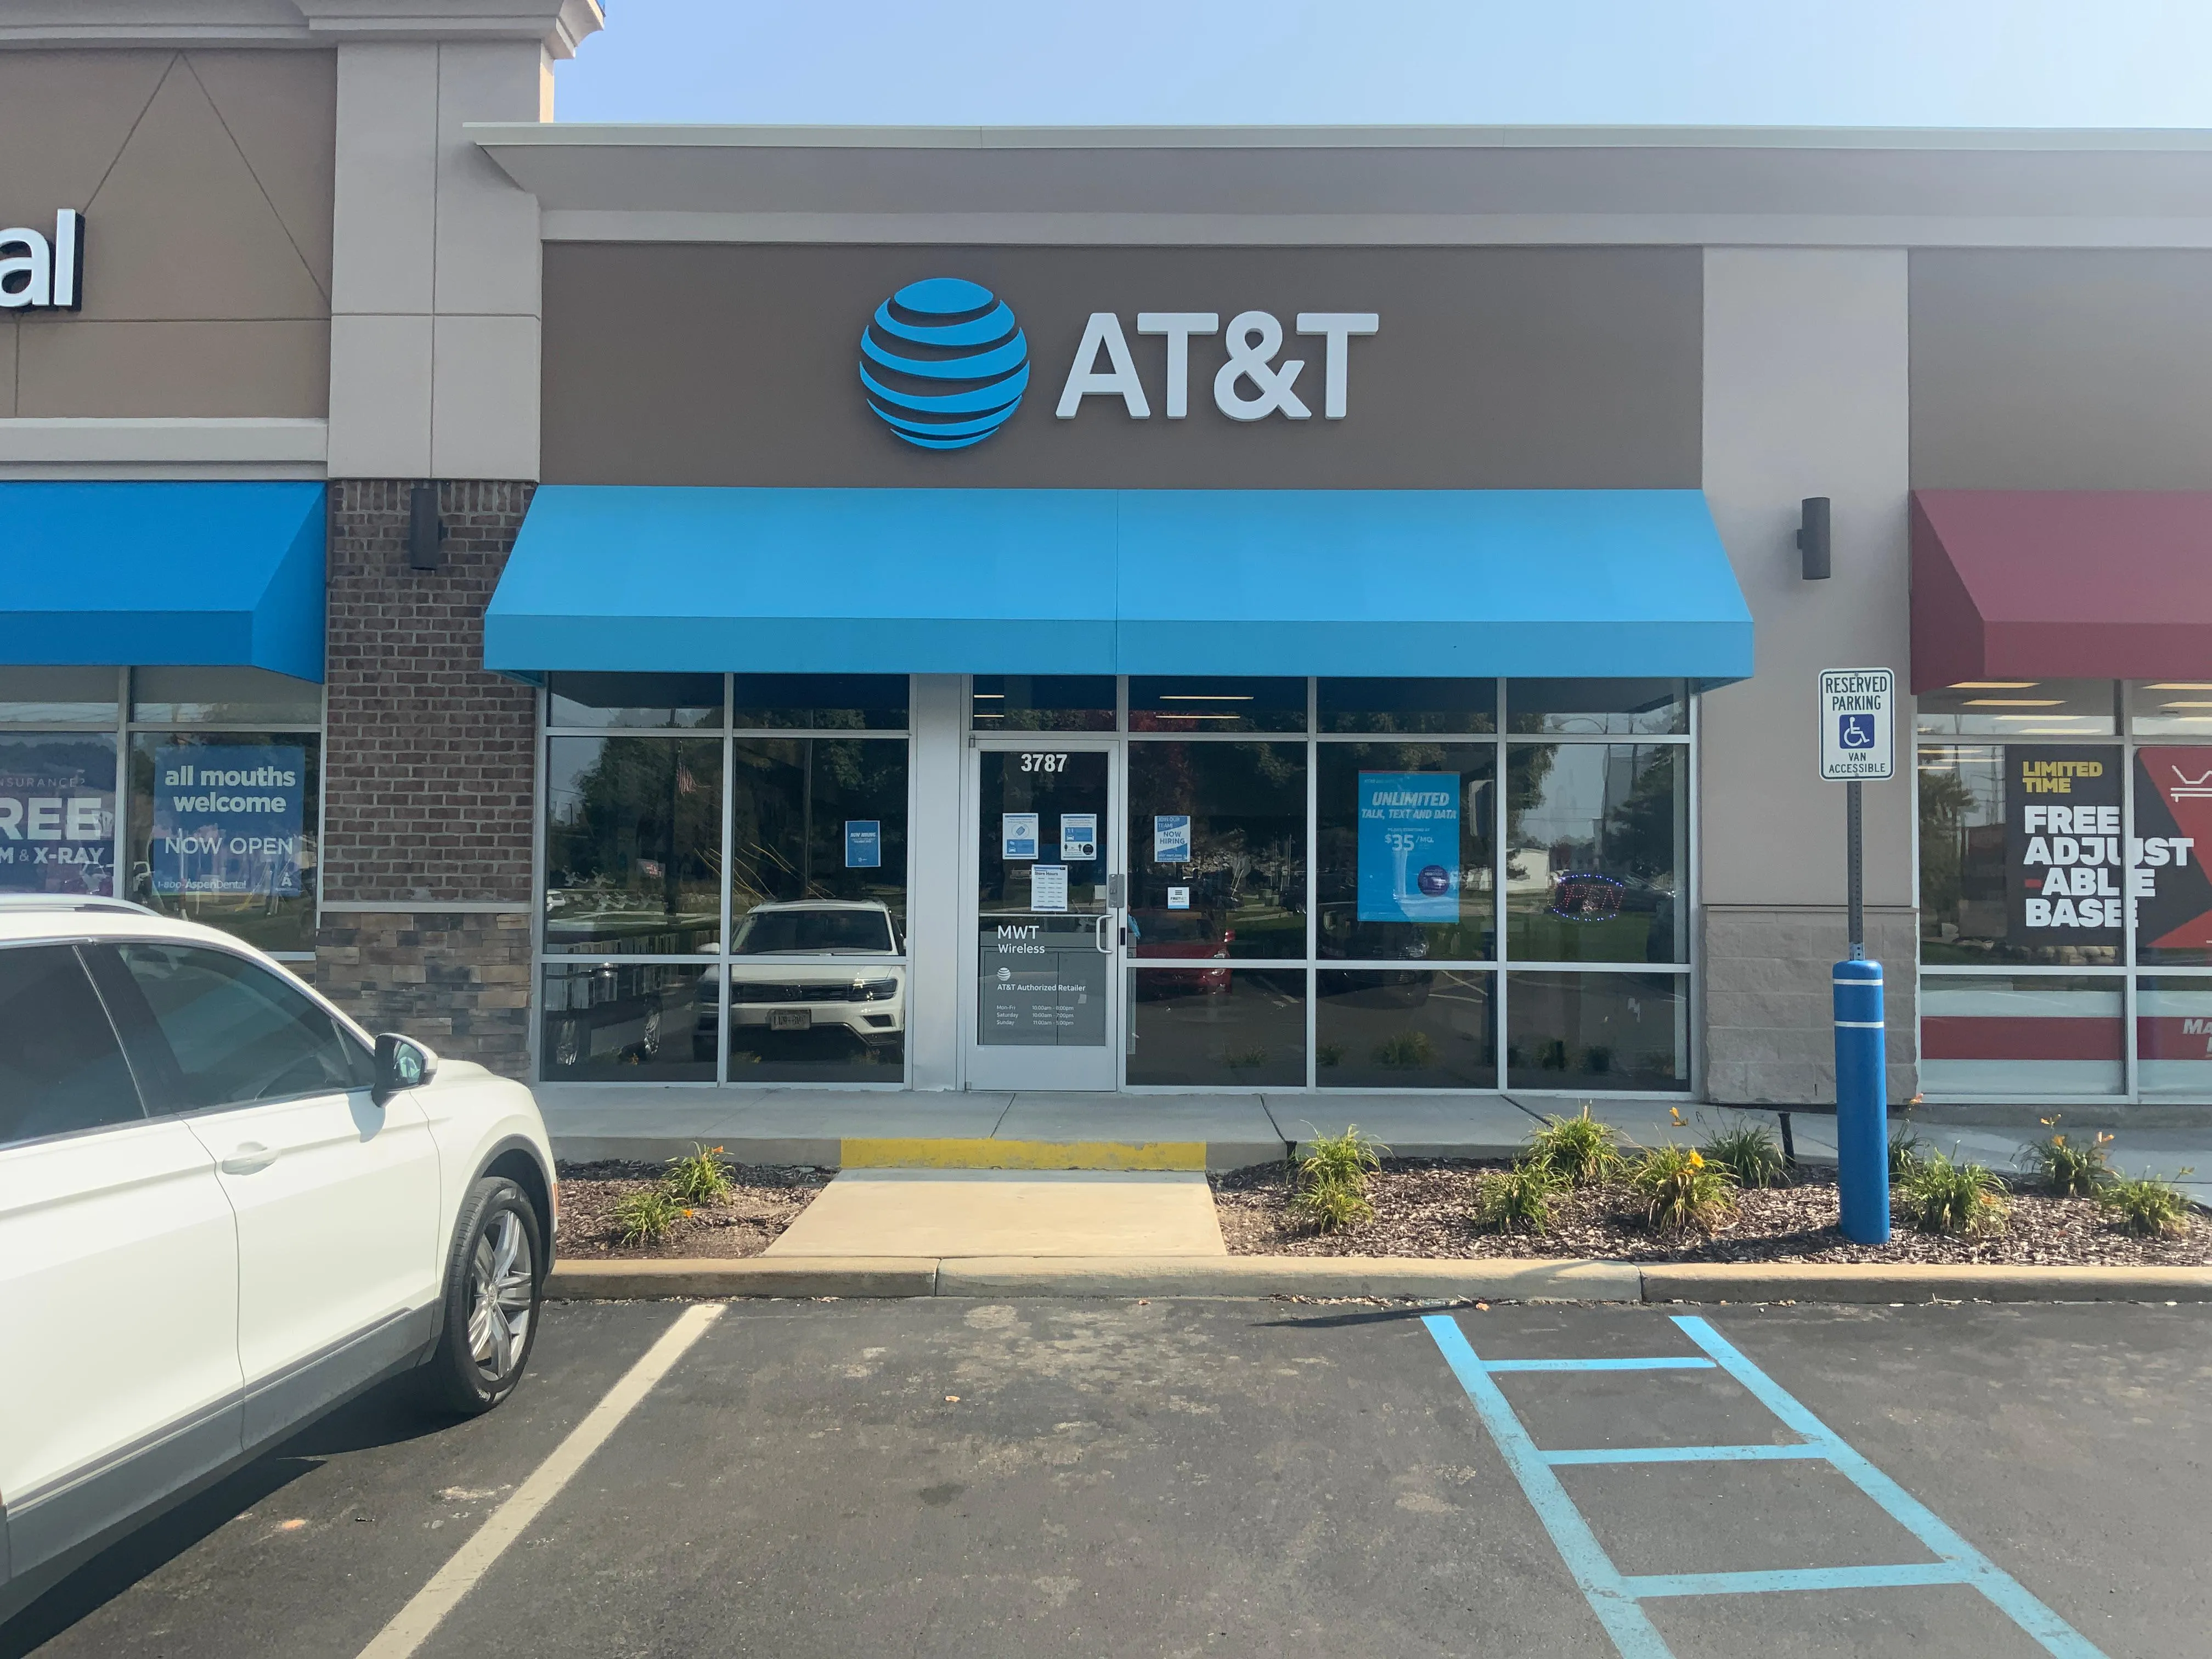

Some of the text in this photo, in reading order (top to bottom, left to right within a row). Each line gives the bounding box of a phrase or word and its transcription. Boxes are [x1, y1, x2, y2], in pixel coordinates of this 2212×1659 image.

[0, 208, 76, 307] al
[1056, 311, 1379, 421] AT&T
[1825, 676, 1887, 693] RESERVED
[1833, 695, 1881, 711] PARKING
[1021, 753, 1068, 772] 3787
[1848, 752, 1866, 761] VAN
[165, 765, 296, 787] all mouths
[1829, 763, 1886, 773] ACCESSIBLE
[2023, 761, 2103, 777] LIMITED
[2023, 777, 2071, 793] TIME
[173, 793, 287, 813] welcome
[1372, 792, 1450, 806] UNLIMITED
[0, 797, 101, 840] REE
[1362, 809, 1457, 820] TALK, TEXT AND DATA
[2024, 805, 2120, 834] FREE
[165, 837, 293, 855] NOW OPEN
[2023, 837, 2194, 866] ADJUST
[33, 847, 104, 865] X-RAY
[1547, 882, 1626, 911] OPEN
[2025, 898, 2138, 928] BASE
[997, 925, 1040, 939] MWT
[998, 944, 1045, 953] Wireless
